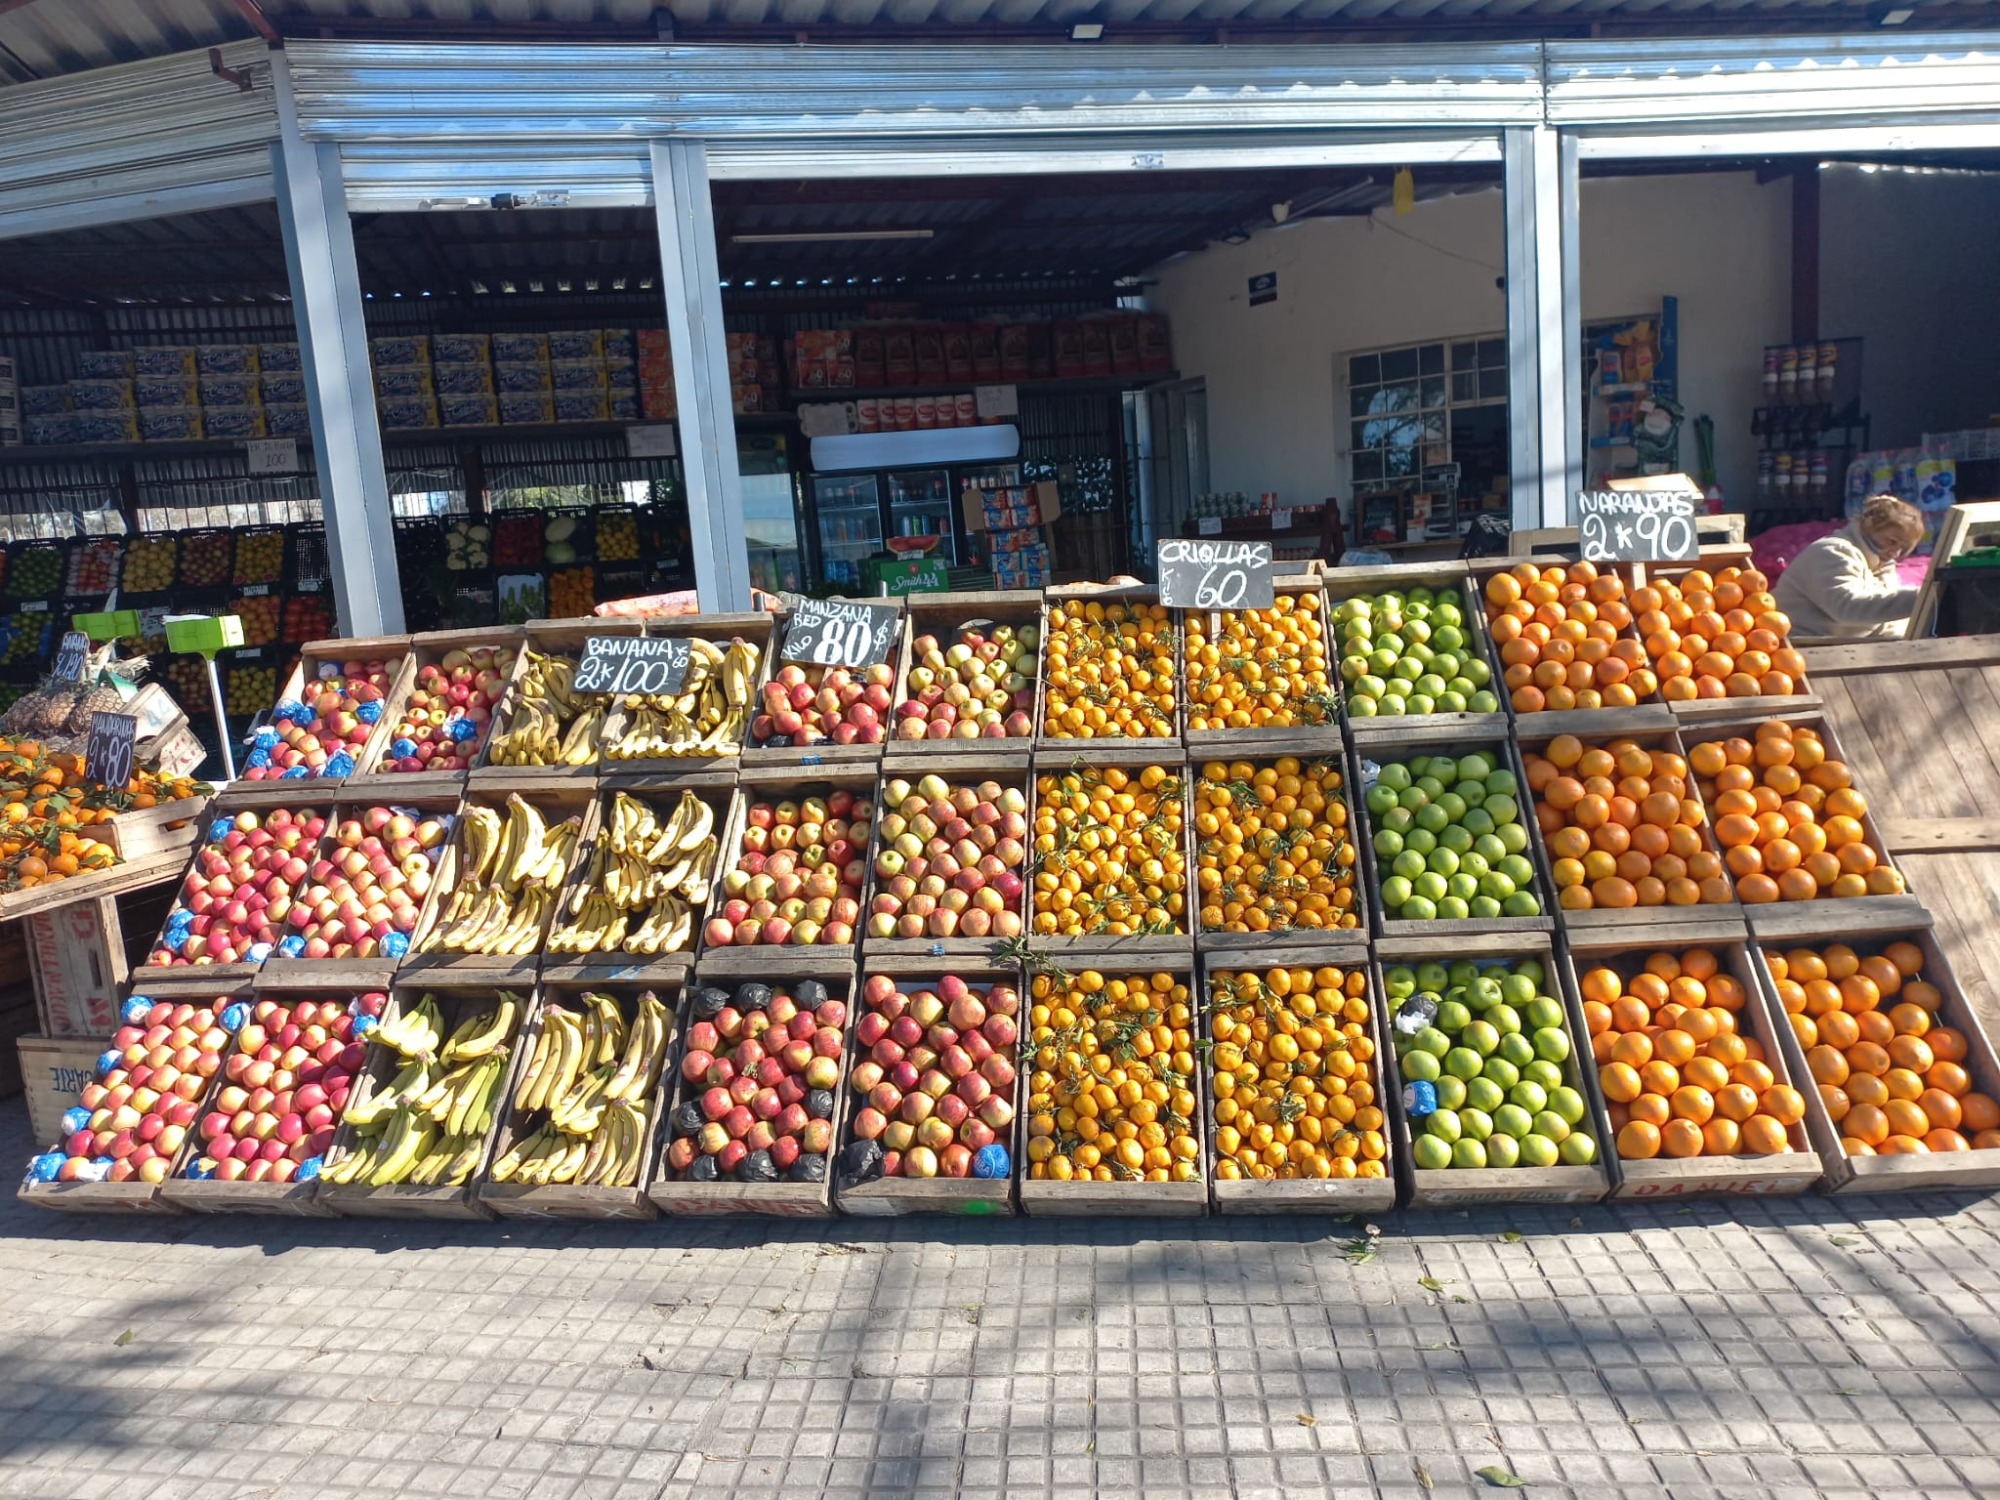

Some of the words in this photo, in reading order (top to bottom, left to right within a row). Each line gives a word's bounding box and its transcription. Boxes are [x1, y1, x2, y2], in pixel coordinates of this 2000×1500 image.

[265, 453, 286, 467] 100
[1579, 491, 1694, 516] NARANJAS
[1636, 512, 1691, 560] 90
[1159, 541, 1268, 569] CRIOLLAS
[891, 574, 921, 590] Smith
[923, 572, 939, 587] 44
[1195, 565, 1247, 608] 60
[800, 600, 872, 624] MANZANA
[588, 638, 673, 660] BANANA
[783, 635, 812, 660] KILO
[813, 618, 872, 667] 80
[607, 657, 669, 692] 100
[106, 736, 131, 788] 80
